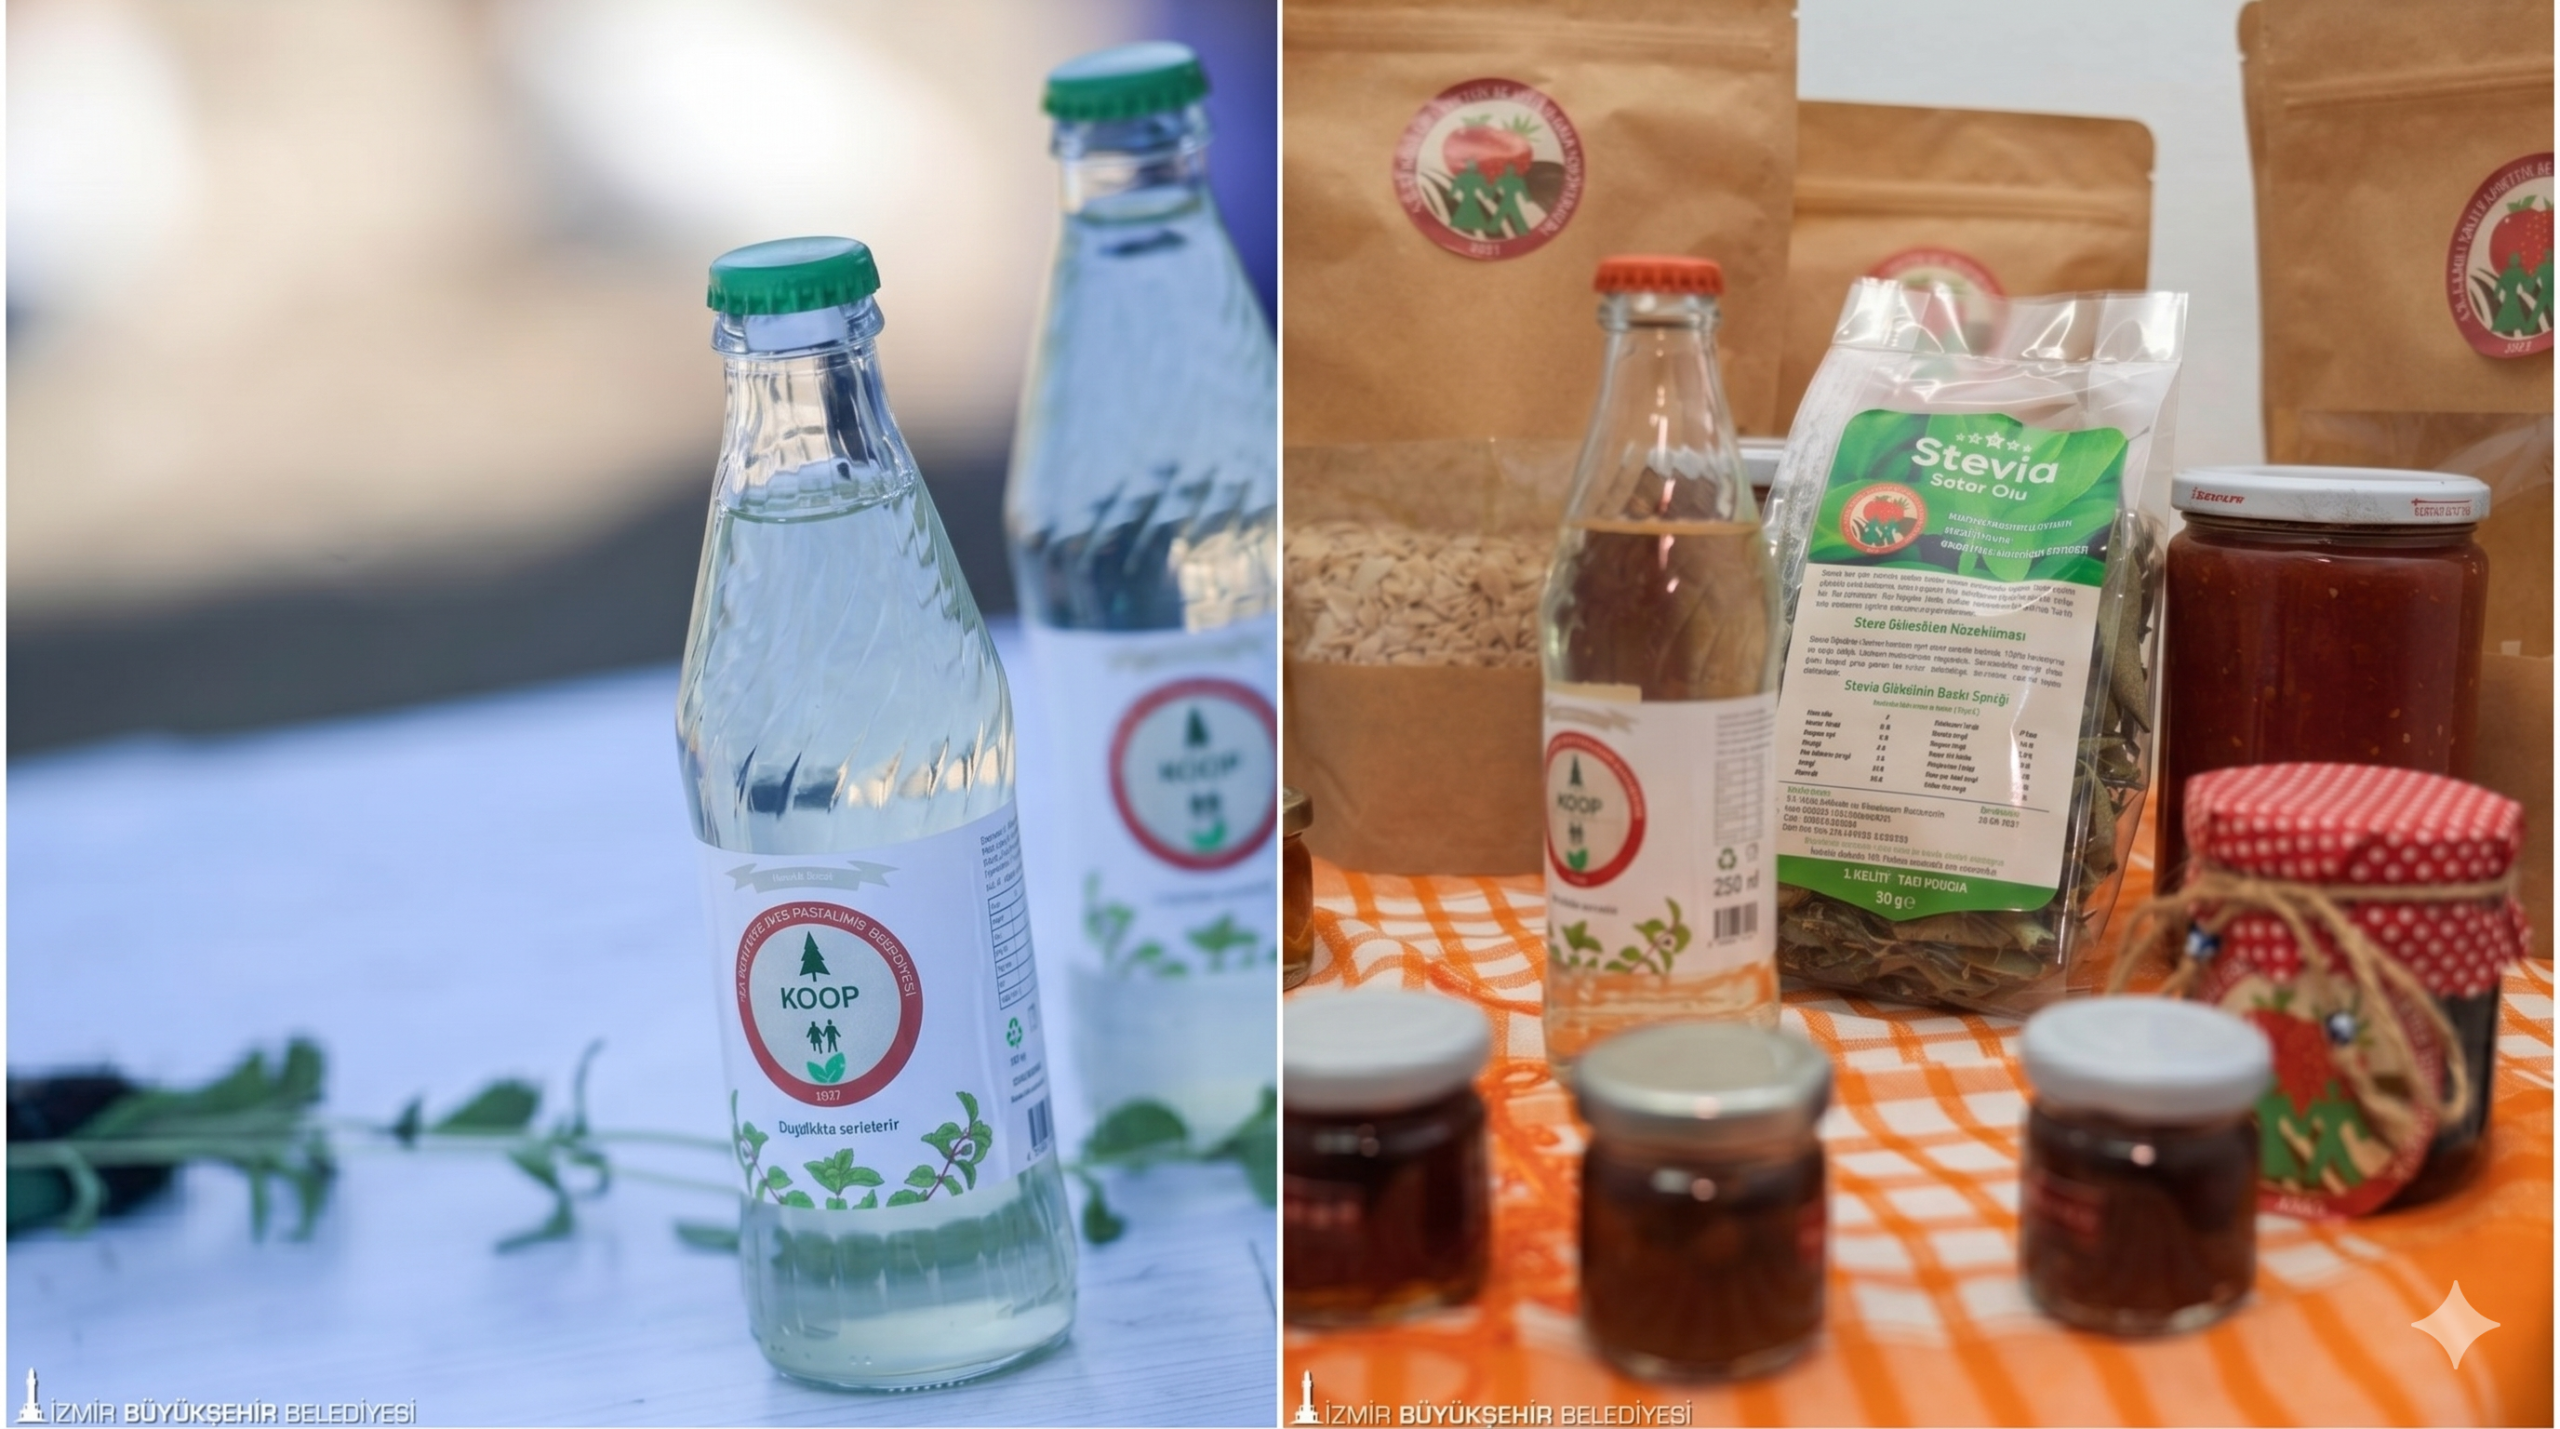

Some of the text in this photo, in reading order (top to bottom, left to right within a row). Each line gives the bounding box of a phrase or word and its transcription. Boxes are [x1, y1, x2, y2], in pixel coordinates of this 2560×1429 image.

[1911, 437, 2059, 484] Stevia
[1844, 679, 1880, 693] Stevia
[1557, 791, 1604, 816] KOOP
[1713, 874, 1742, 897] 250
[1875, 890, 1893, 906] 30
[781, 985, 860, 1010] KOOP
